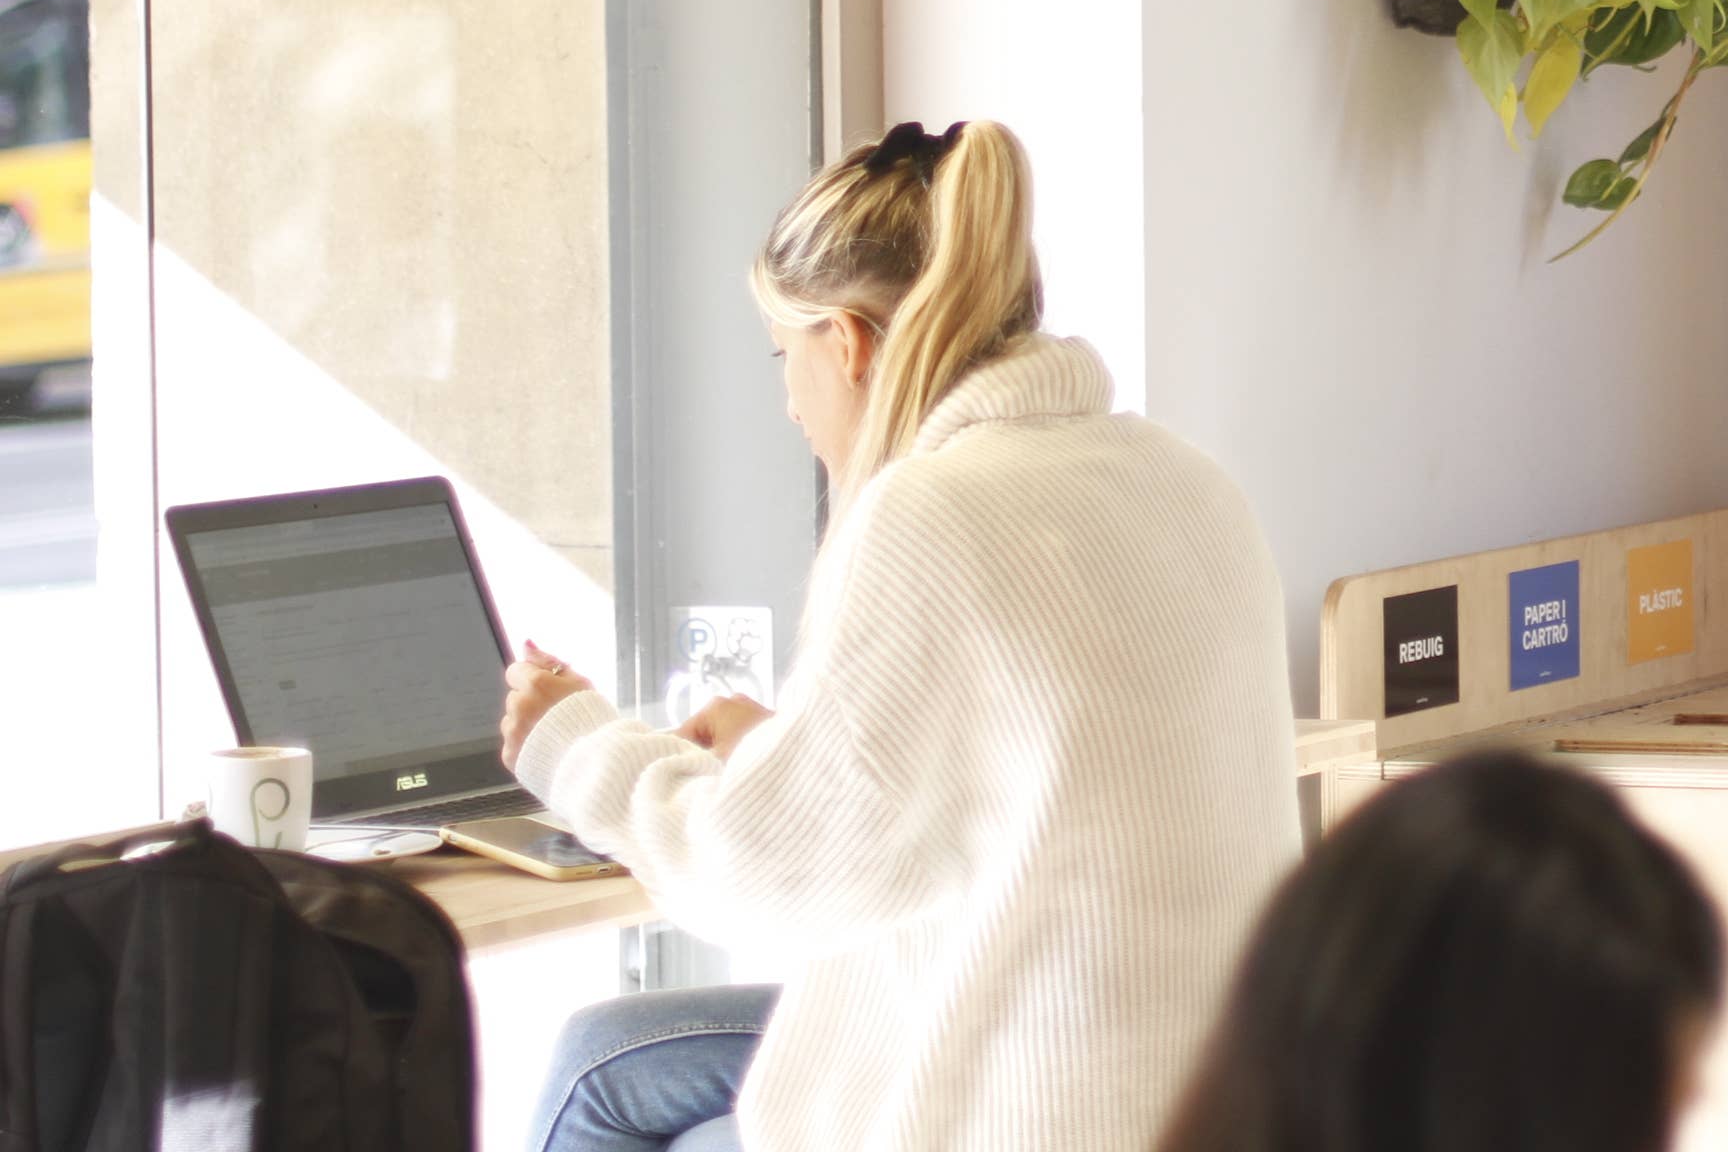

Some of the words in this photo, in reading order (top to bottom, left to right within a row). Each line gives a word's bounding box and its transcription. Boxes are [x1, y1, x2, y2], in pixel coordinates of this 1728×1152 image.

[1524, 600, 1560, 626] PAPER
[1639, 587, 1683, 615] PLÀSTIC
[1522, 619, 1568, 650] CARTRÓ
[1399, 635, 1444, 664] REBUIG
[396, 773, 428, 791] ASUS
